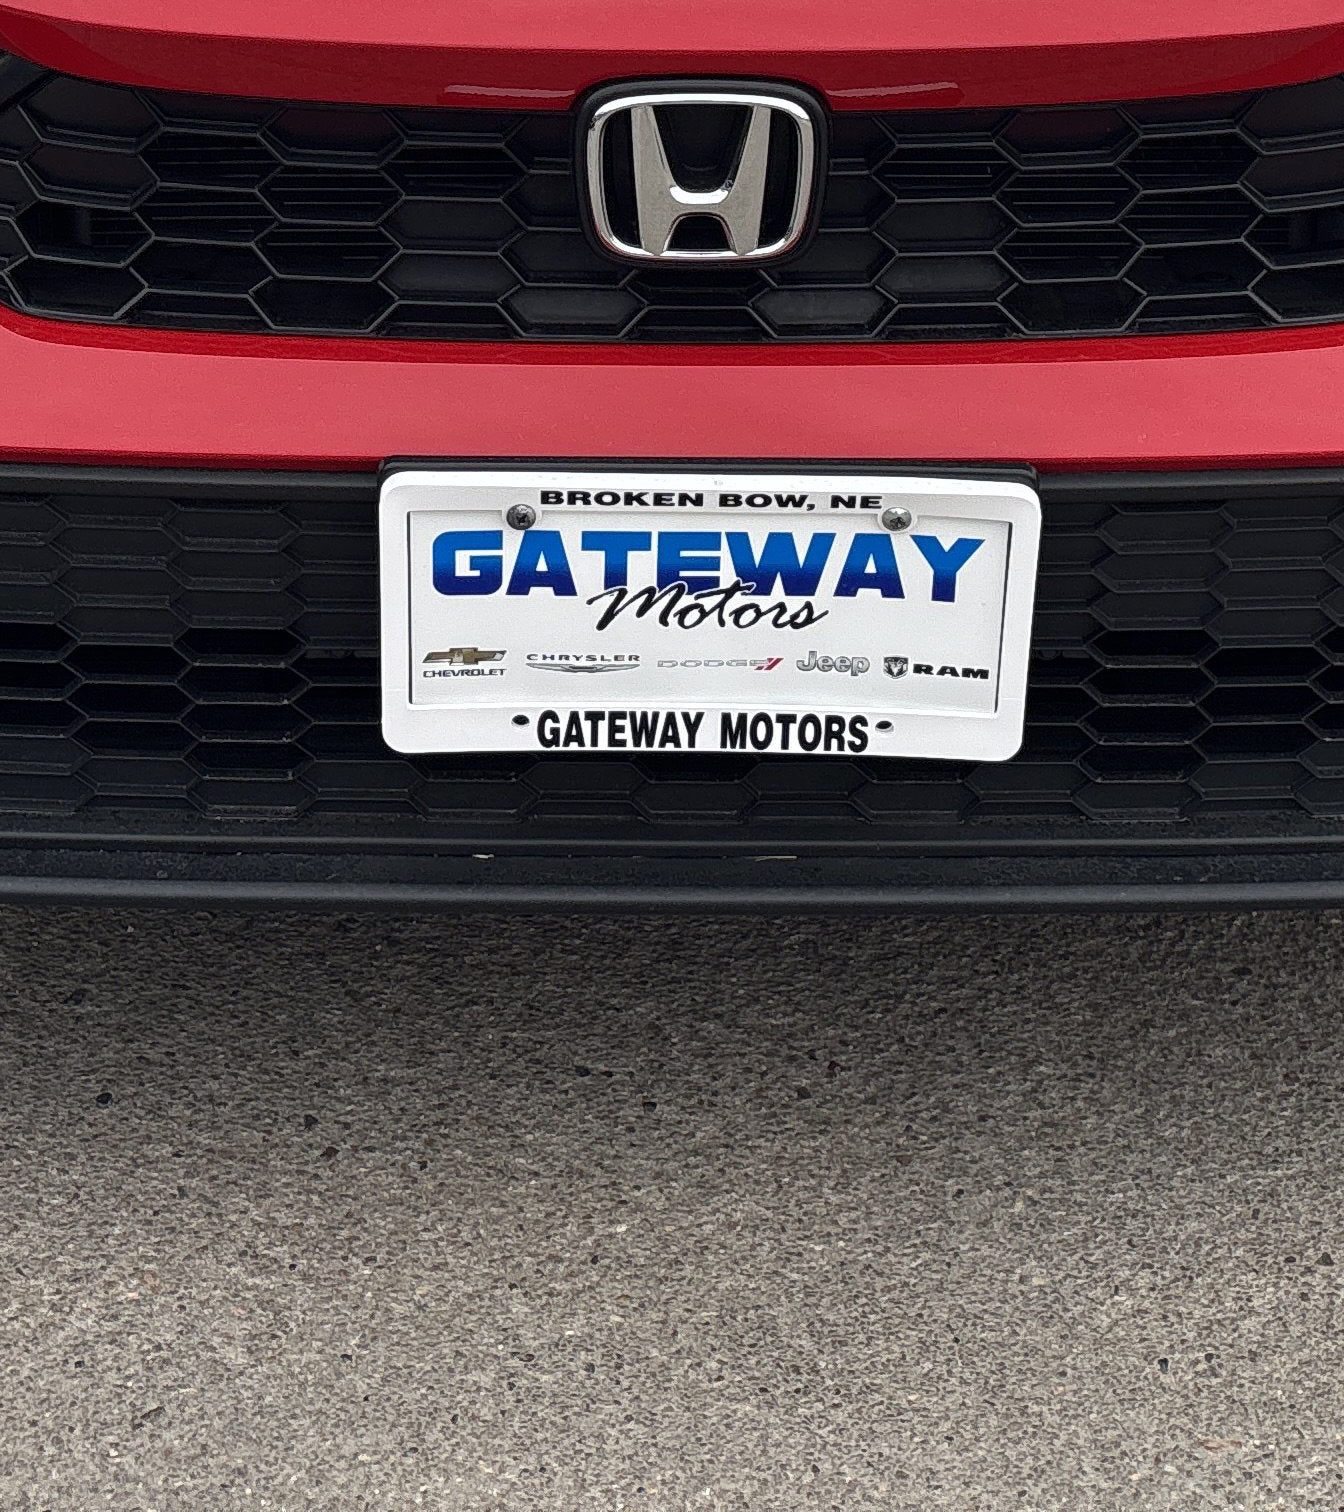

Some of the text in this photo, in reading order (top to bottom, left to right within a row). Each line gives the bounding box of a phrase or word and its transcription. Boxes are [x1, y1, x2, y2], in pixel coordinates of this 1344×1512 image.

[540, 489, 883, 511] BROKEN BOW, NE
[432, 529, 987, 603] GATEWAY
[585, 579, 829, 631] Motors
[525, 653, 641, 662] CHRYSLER
[657, 658, 768, 668] DODGE
[796, 650, 871, 677] Jeep
[422, 668, 506, 678] CHEVROLET
[912, 663, 990, 680] RAM
[536, 709, 869, 753] GATEWAY MOTORS
